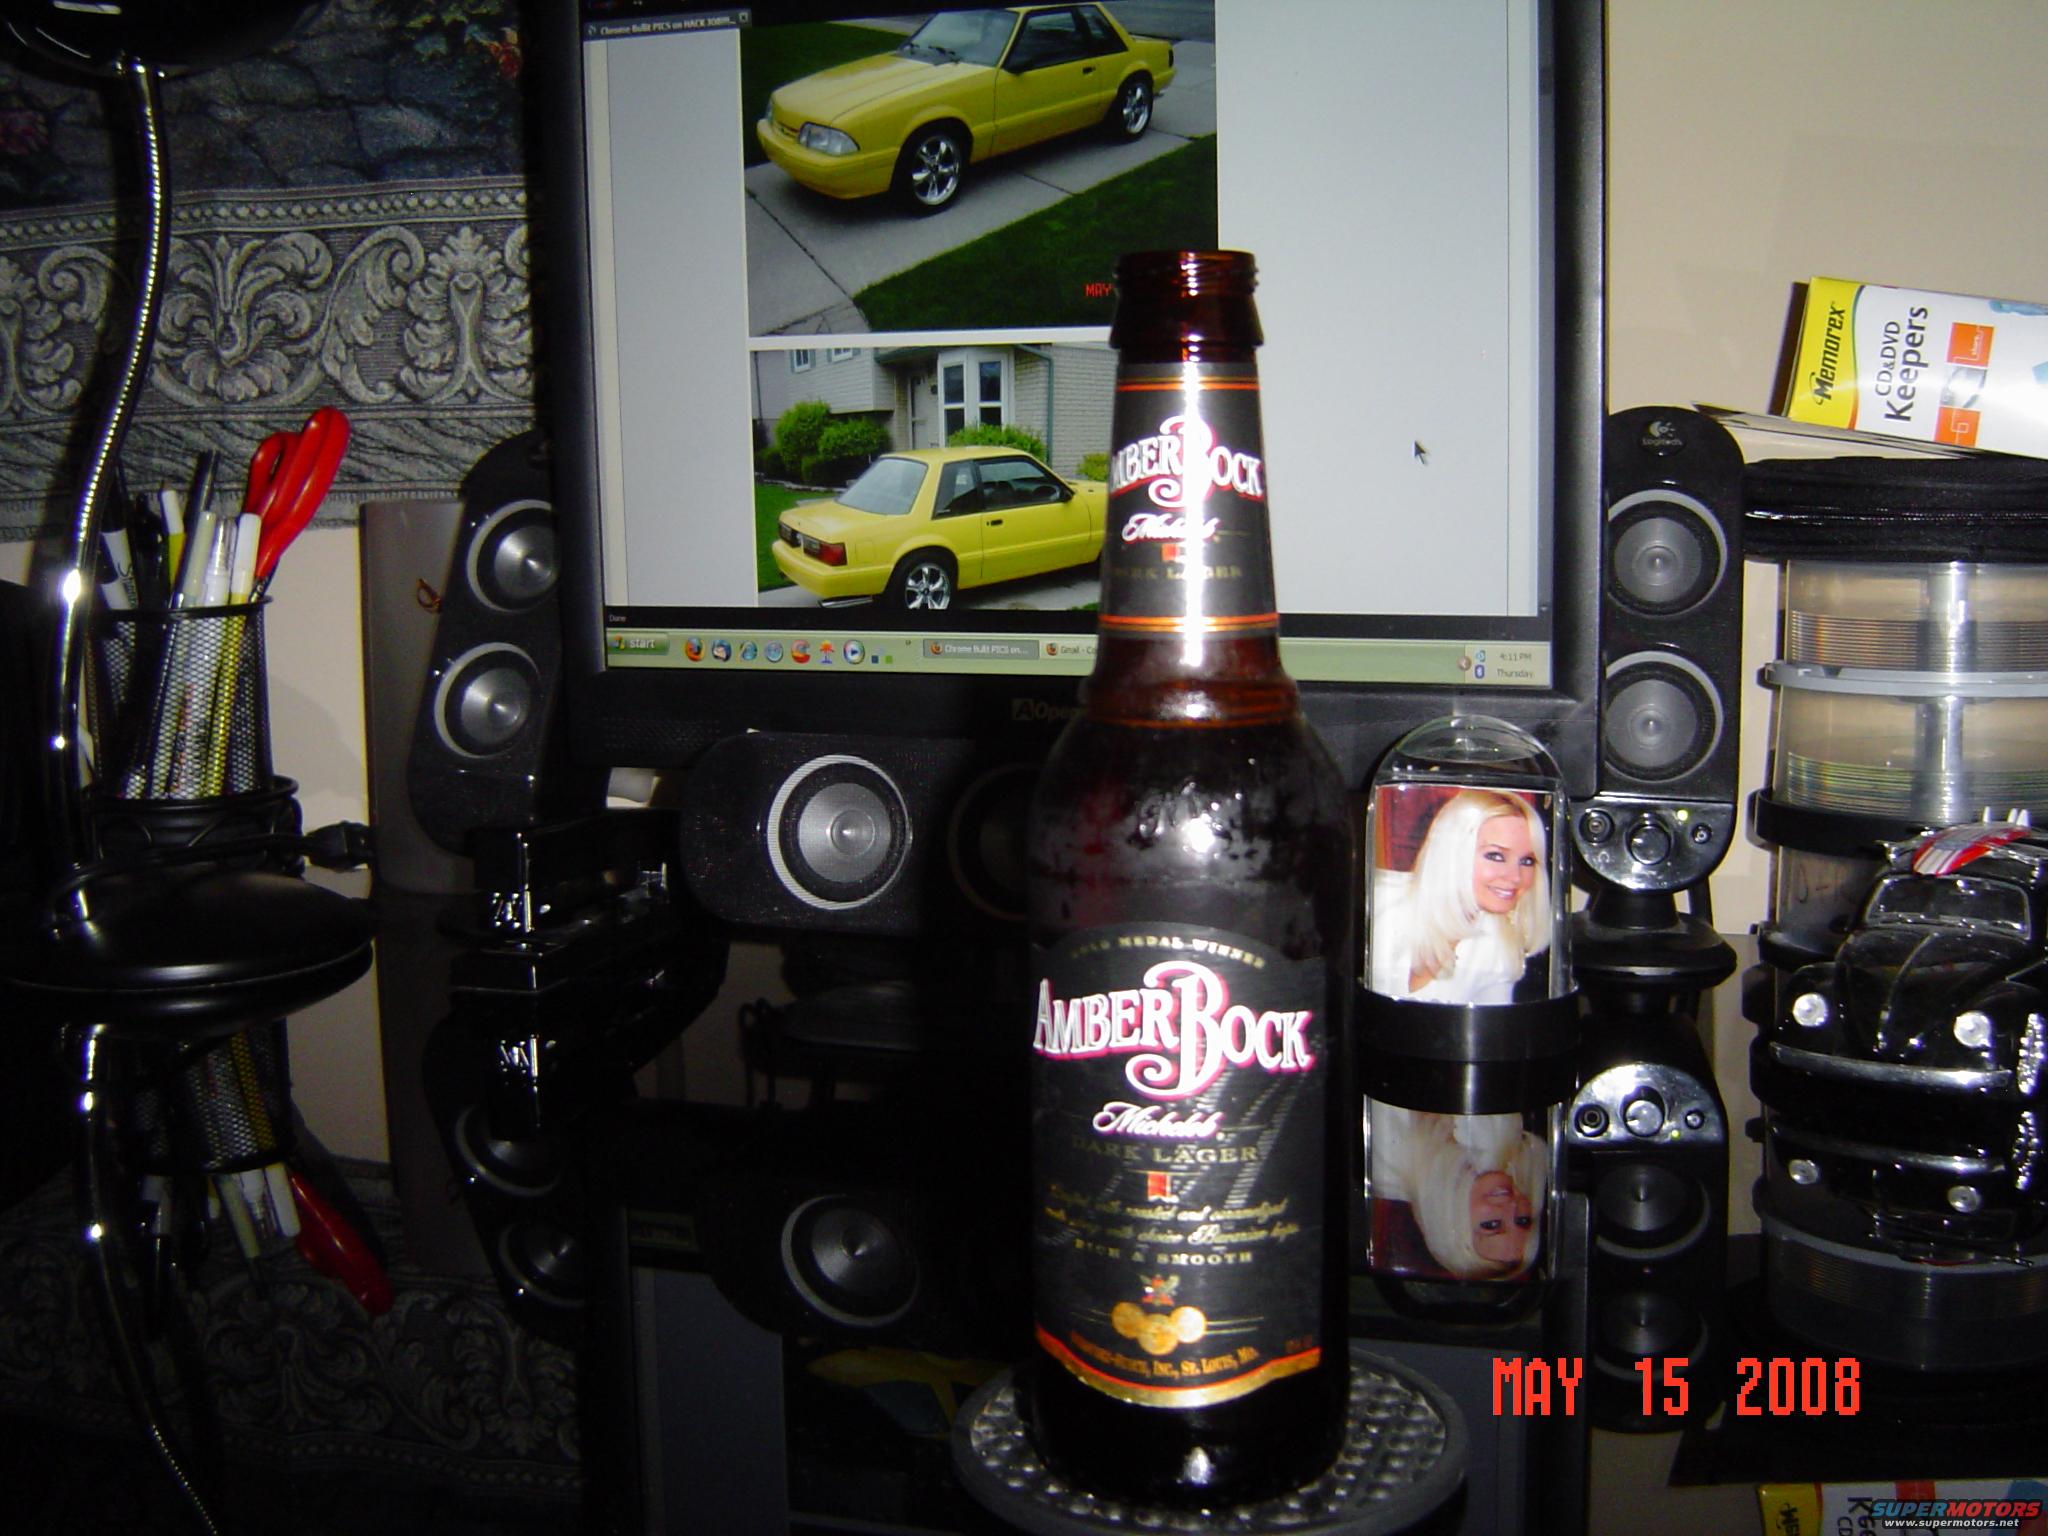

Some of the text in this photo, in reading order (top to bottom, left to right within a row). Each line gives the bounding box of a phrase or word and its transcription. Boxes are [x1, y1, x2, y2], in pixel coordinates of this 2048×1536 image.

[1808, 306, 1846, 406] Memorex
[1885, 306, 1928, 421] Keepers
[608, 614, 627, 622] Done
[629, 638, 656, 649] start
[1060, 646, 1080, 655] Gmail
[1497, 668, 1535, 679] Thursday
[1117, 935, 1183, 950] MEDAL
[1191, 938, 1266, 969] WINNER
[1071, 1135, 1258, 1164] DARK LAGER
[1156, 1250, 1254, 1266] SMOOTH
